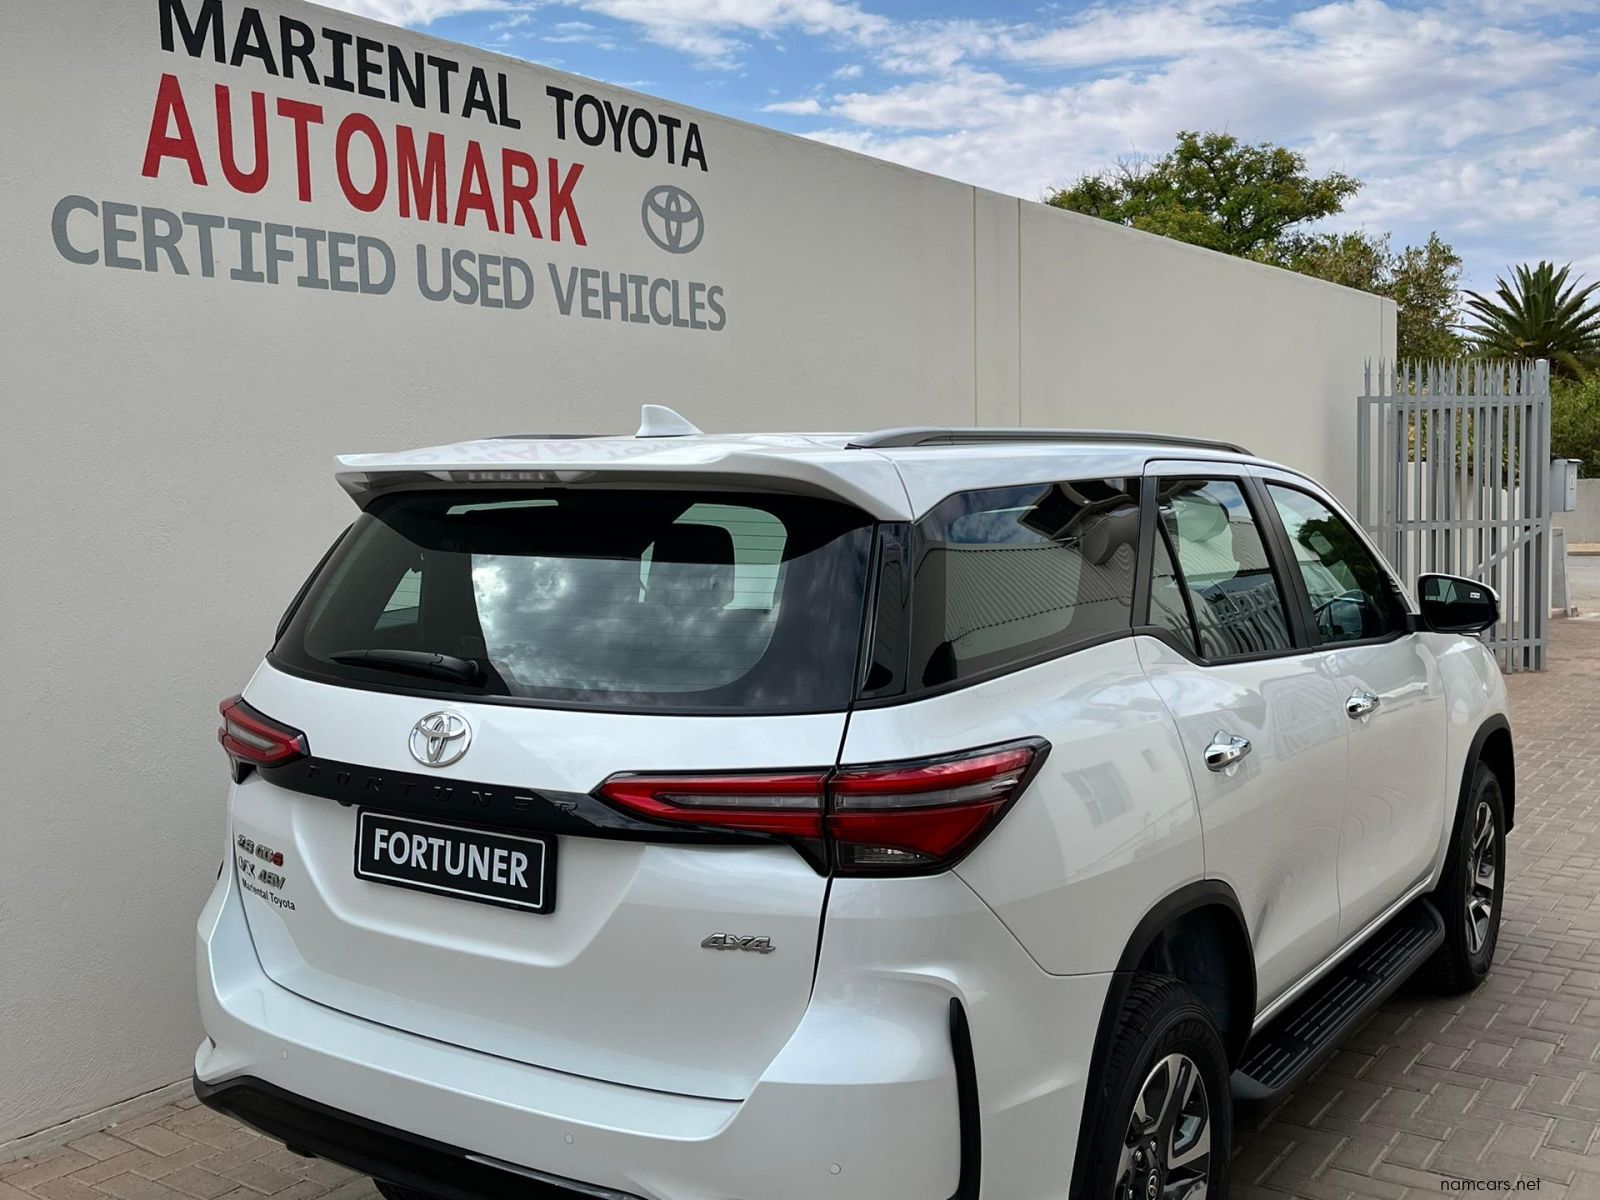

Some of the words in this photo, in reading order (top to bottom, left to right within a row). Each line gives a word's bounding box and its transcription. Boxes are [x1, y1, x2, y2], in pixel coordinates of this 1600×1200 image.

[159, 0, 521, 130] MARIENTAL
[546, 85, 709, 172] TOYOTA
[141, 73, 588, 246] AUTOMARK
[51, 194, 396, 296] CERTIFIED
[416, 243, 534, 310] USED
[548, 262, 727, 332] VEHICLES
[269, 891, 296, 911] Toyota
[373, 827, 529, 889] FORTUNER
